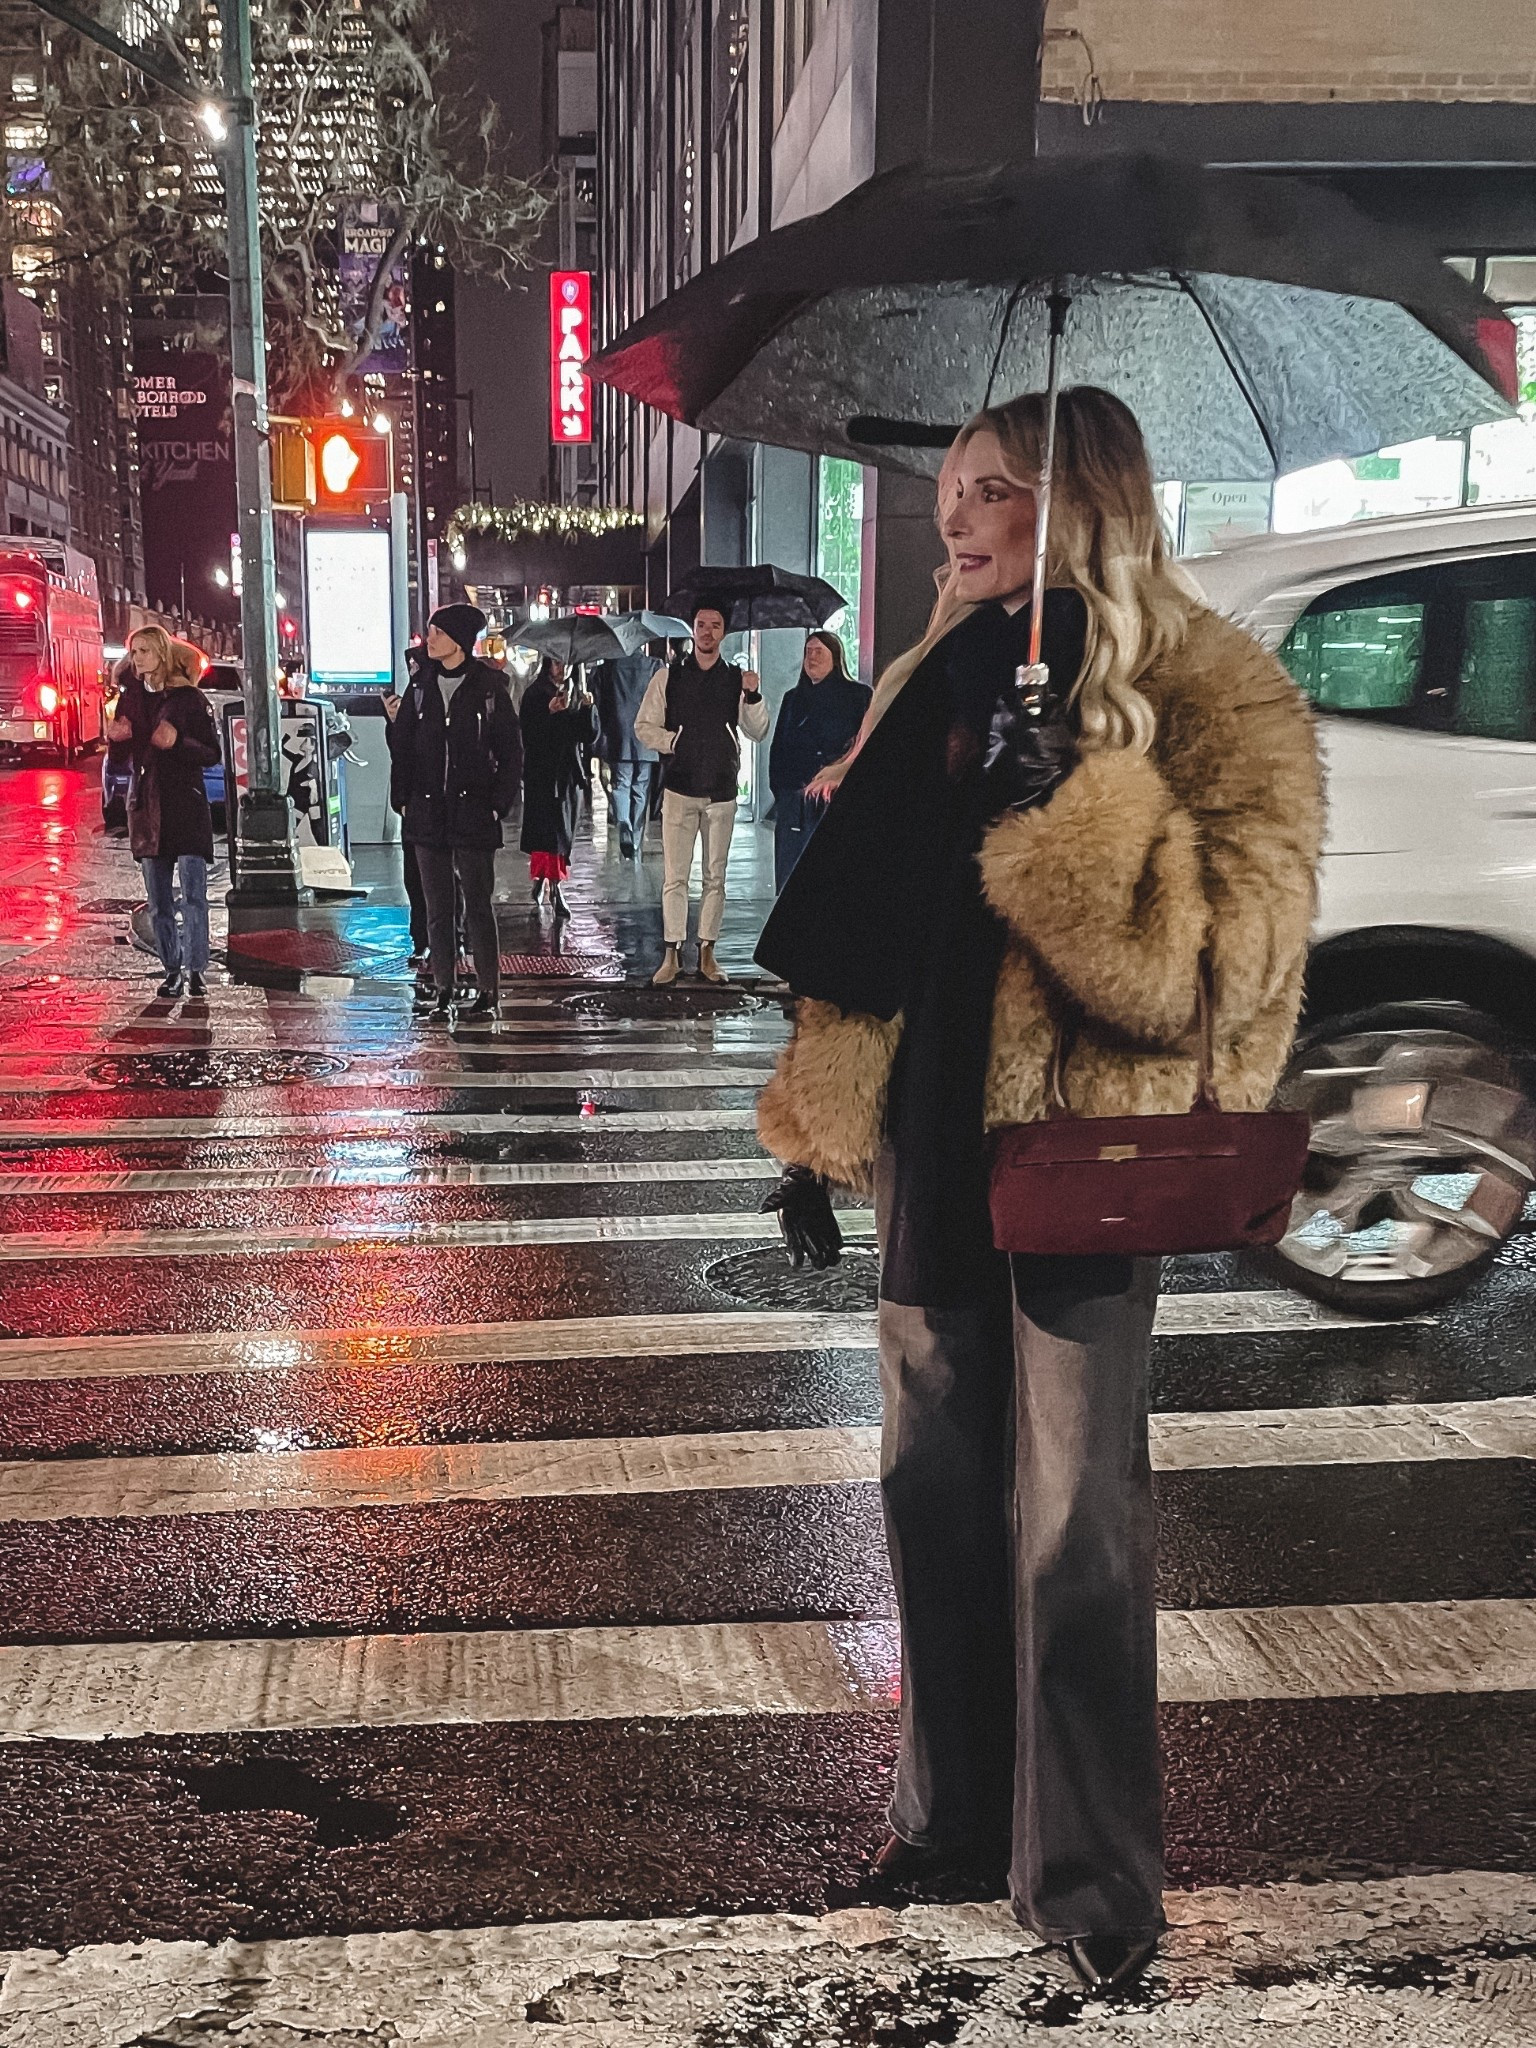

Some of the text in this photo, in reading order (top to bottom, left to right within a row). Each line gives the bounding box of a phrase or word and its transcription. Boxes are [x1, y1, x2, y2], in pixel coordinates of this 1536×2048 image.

[559, 307, 585, 412] PARK
[140, 441, 229, 461] KITCHEN
[1212, 491, 1247, 506] Open
